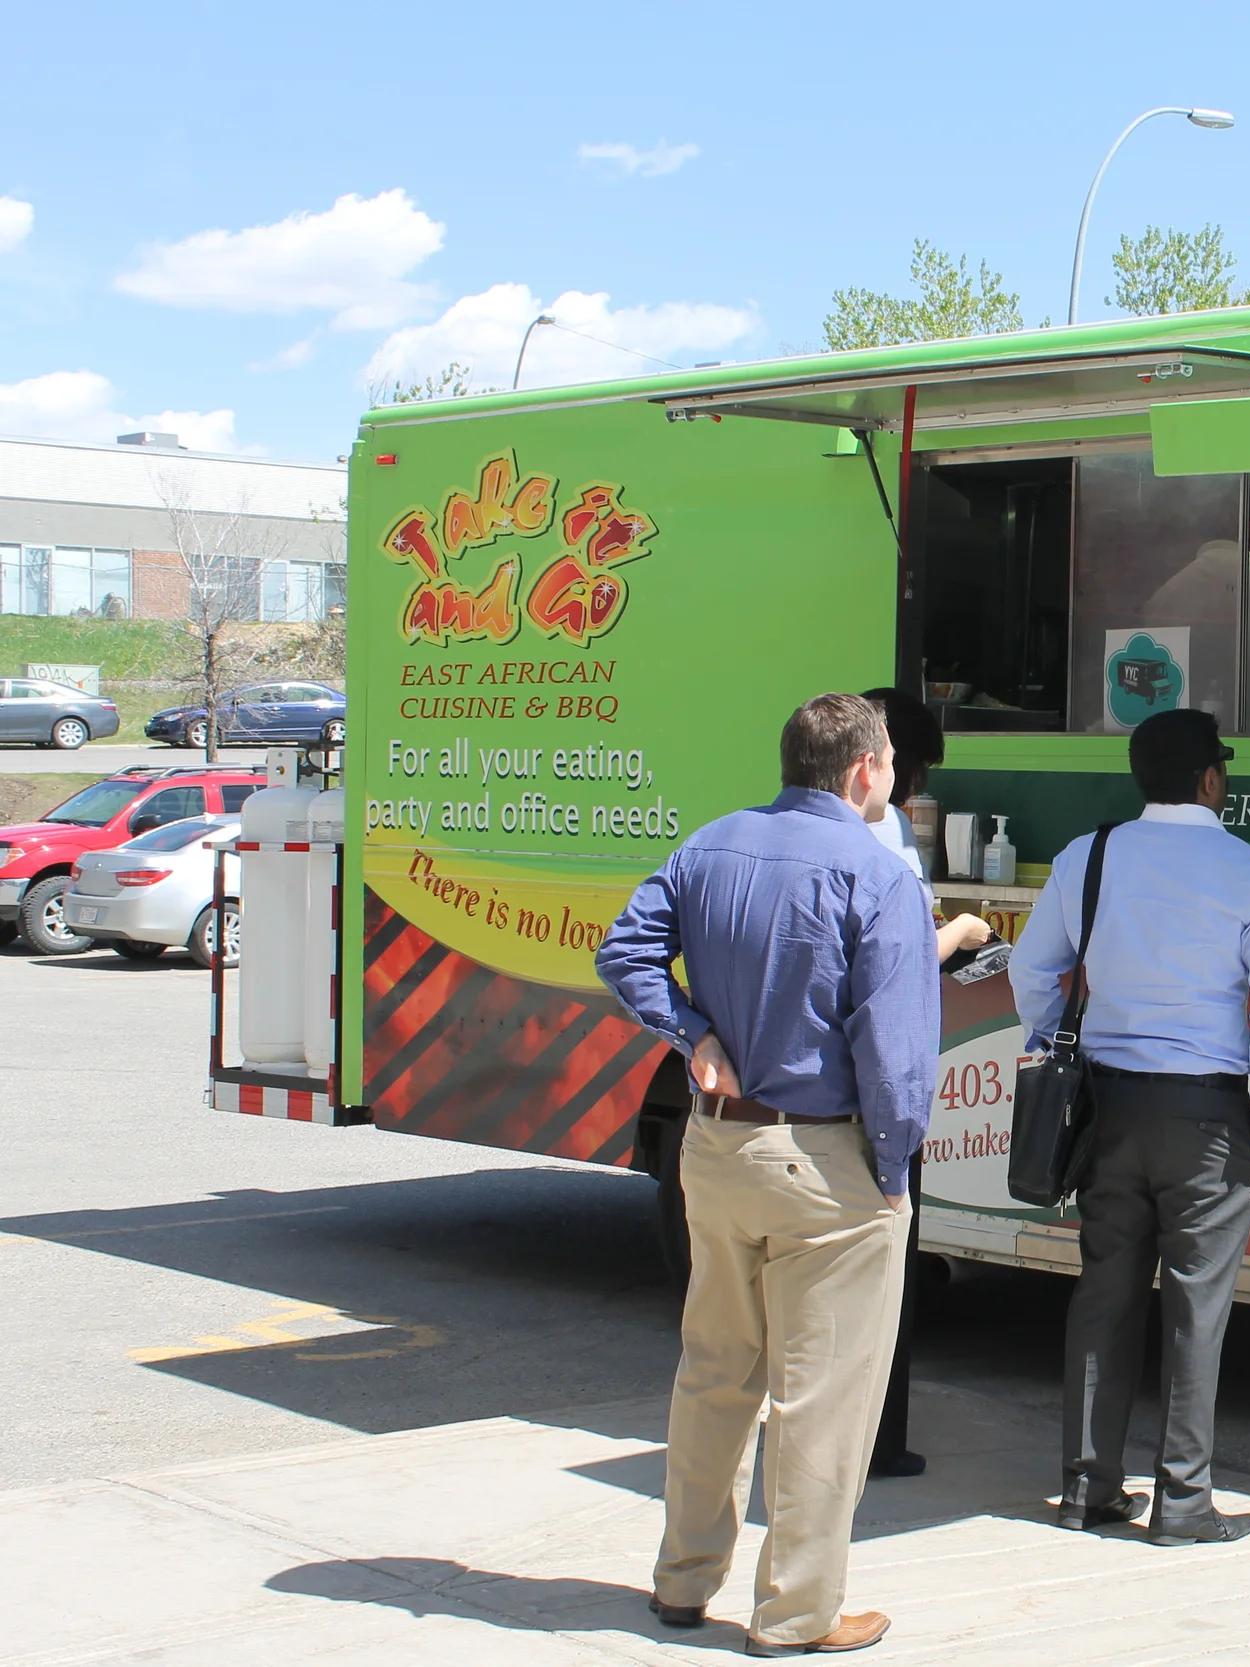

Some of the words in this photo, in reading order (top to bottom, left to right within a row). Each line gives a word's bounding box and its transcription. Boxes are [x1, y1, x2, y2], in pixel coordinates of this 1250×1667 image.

[381, 455, 556, 578] Take
[403, 560, 516, 640] and
[527, 555, 623, 640] Go
[401, 663, 472, 686] EAST
[477, 660, 617, 685] AFRICAN
[1124, 665, 1139, 681] YYC
[400, 697, 515, 719] CUISINE
[524, 697, 548, 719] &
[556, 695, 619, 723] BBQ
[388, 739, 430, 777] For
[439, 737, 470, 778] all
[479, 748, 543, 787] your
[552, 740, 653, 789] eating,
[366, 796, 432, 839] party
[440, 791, 490, 832] and
[501, 792, 580, 835] office
[591, 796, 680, 840] needs
[407, 848, 480, 916] There
[485, 887, 509, 930] is
[517, 907, 551, 942] no
[559, 905, 612, 952] lov
[939, 1057, 1033, 1110] 403.
